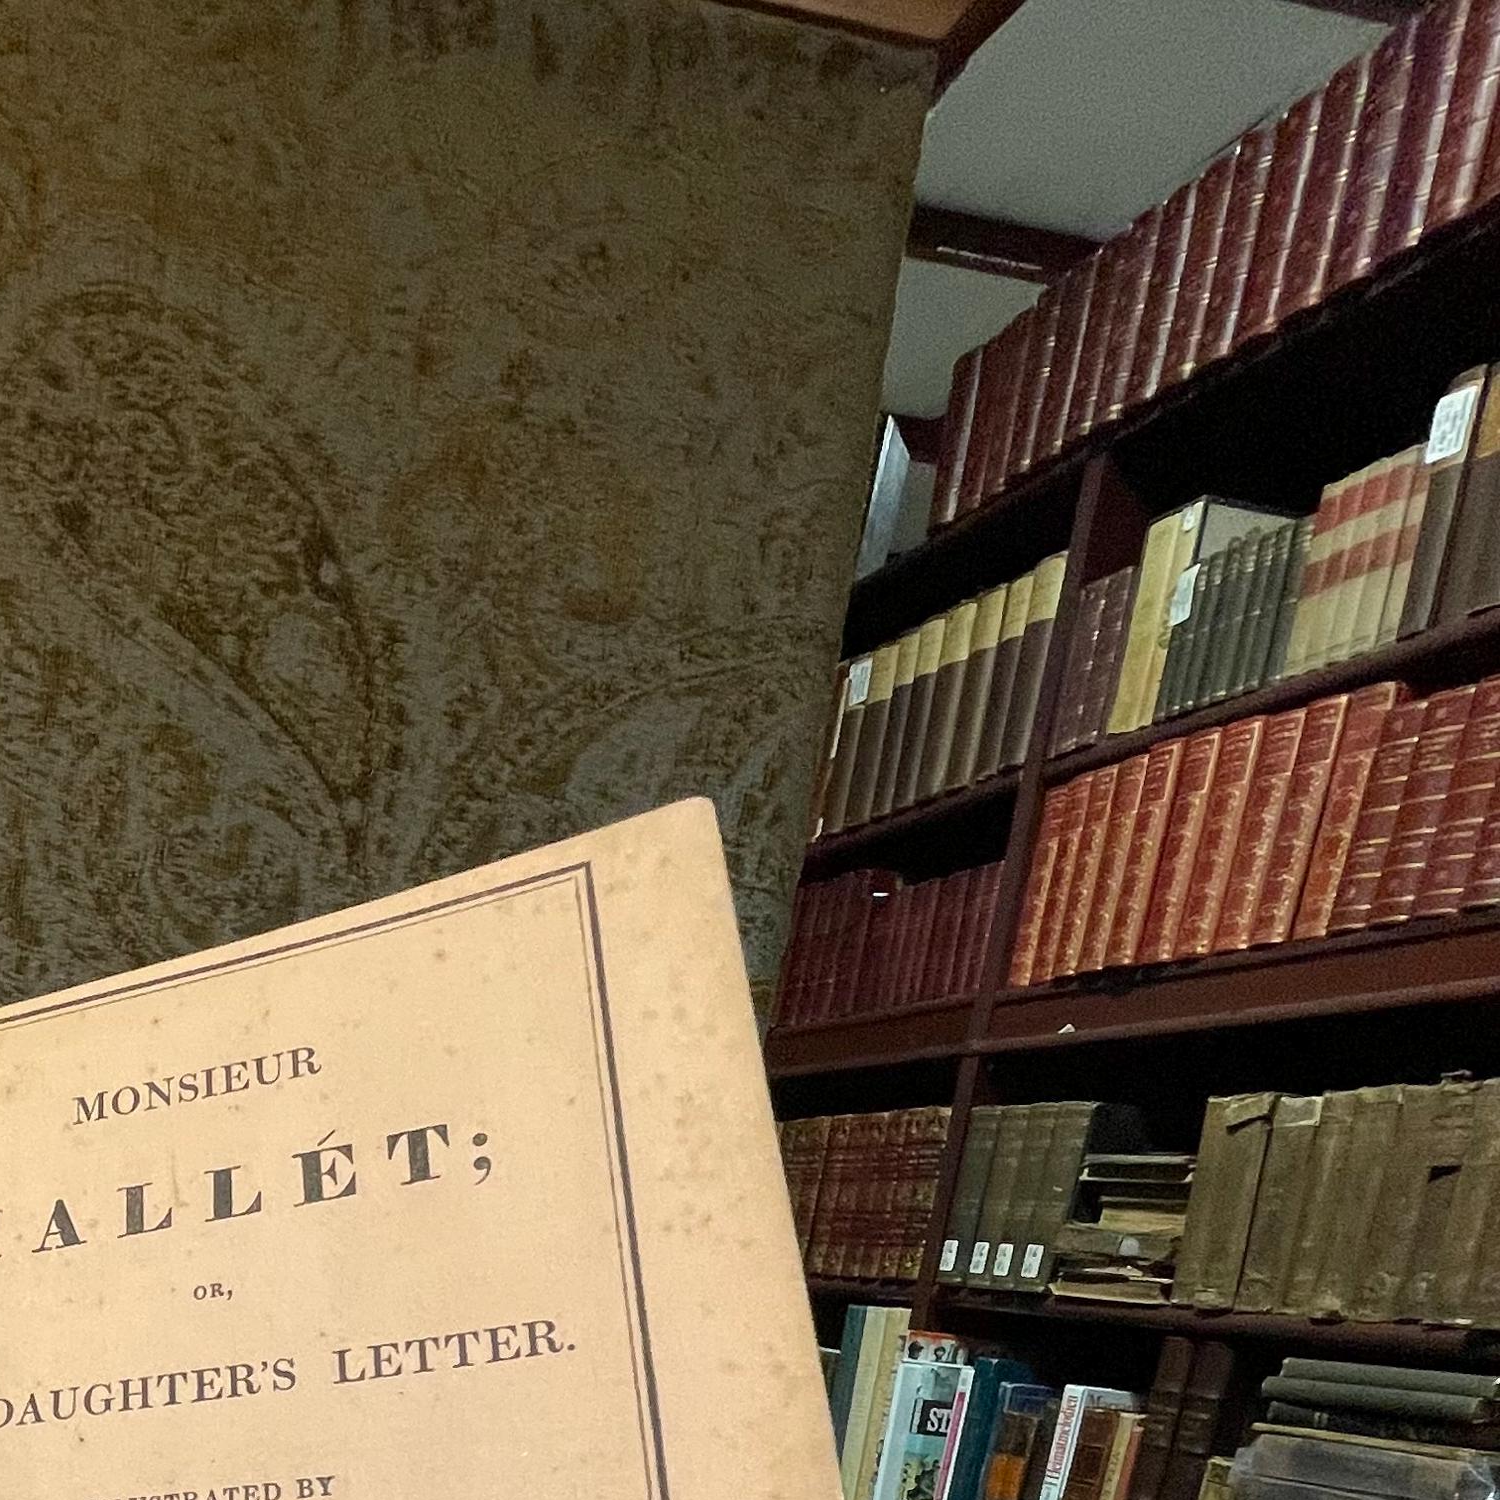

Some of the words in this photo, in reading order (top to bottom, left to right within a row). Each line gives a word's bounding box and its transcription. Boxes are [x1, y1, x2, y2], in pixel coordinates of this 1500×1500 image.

[71, 1046, 323, 1126] MONSIEUR
[192, 1282, 233, 1301] OR,
[331, 1319, 576, 1385] LETTER.
[295, 1474, 336, 1500] BY
